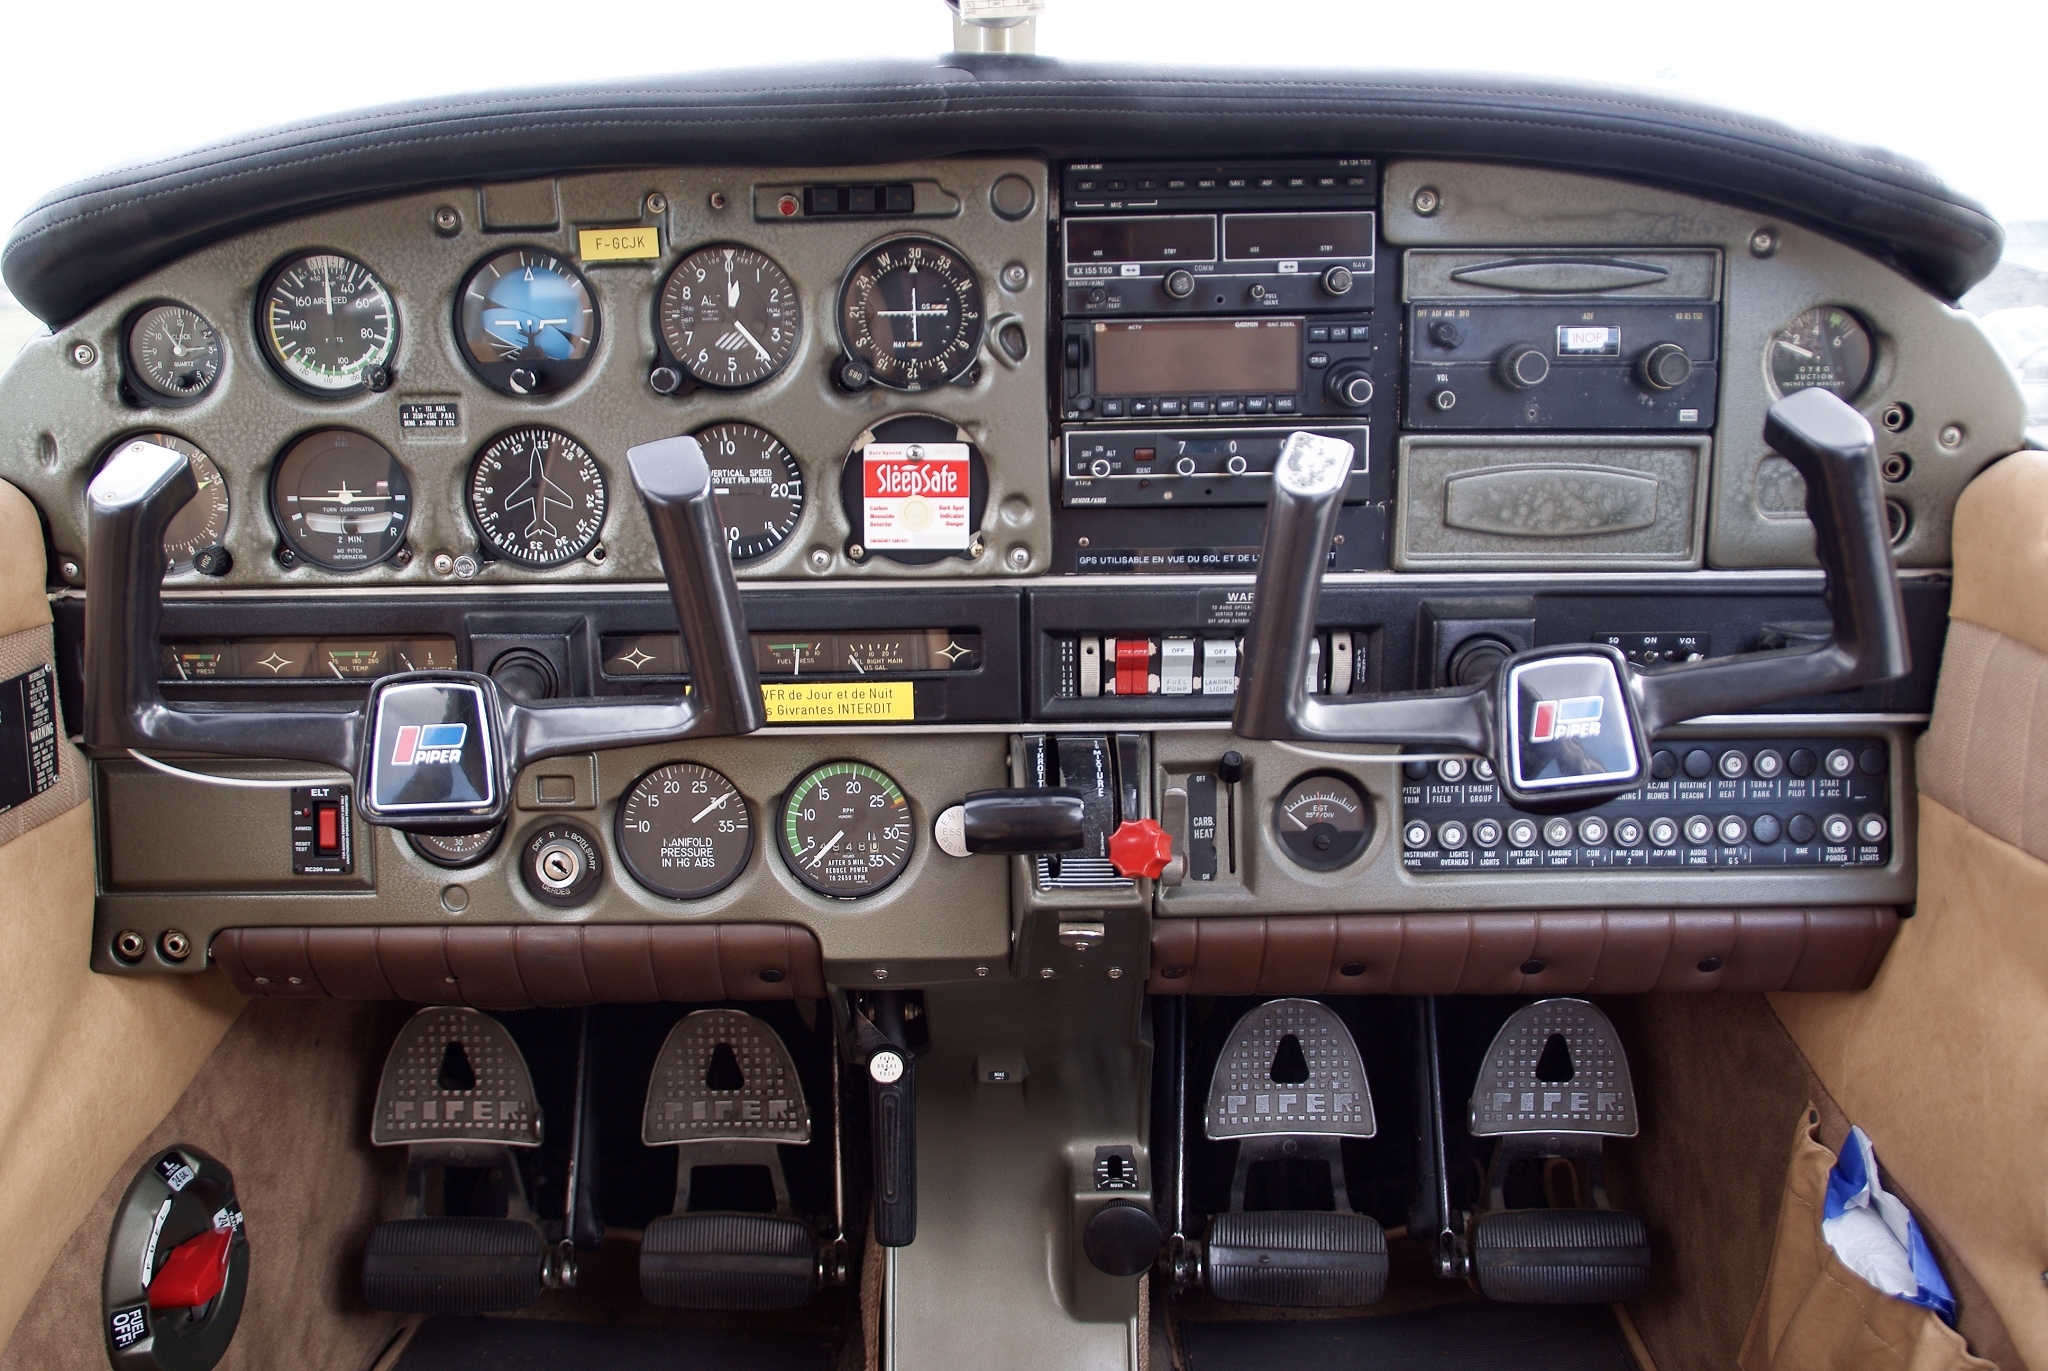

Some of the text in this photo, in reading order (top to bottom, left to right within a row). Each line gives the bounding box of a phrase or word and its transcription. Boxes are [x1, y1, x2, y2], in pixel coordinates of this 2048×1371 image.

[596, 236, 645, 250] F-GCJK
[908, 248, 922, 258] 30
[1074, 267, 1112, 275] KX 155 TSO
[856, 275, 870, 288] 24
[296, 296, 312, 306] 160
[356, 298, 370, 308] 60
[360, 328, 374, 338] 80
[1572, 332, 1604, 344] INOP
[848, 369, 862, 380] OBS
[1437, 374, 1448, 382] VOL
[720, 440, 736, 455] 10
[750, 468, 772, 476] SPEED
[876, 463, 958, 496] SleepSafe
[770, 483, 789, 498] 20
[201, 554, 212, 568] HDG
[1080, 556, 1097, 564] GPS
[1100, 555, 1150, 564] UTILISABLE
[1153, 555, 1164, 564] EN
[1168, 554, 1185, 563] VUE
[1188, 554, 1200, 563] DU
[1203, 554, 1220, 562] SOL
[1223, 554, 1234, 562] ET
[1238, 554, 1250, 562] DE
[1608, 637, 1620, 645] SQ
[1644, 636, 1658, 644] ON
[1679, 637, 1696, 645] VOL
[788, 688, 803, 700] de
[806, 688, 834, 700] Jour
[836, 688, 848, 700] et
[852, 688, 866, 700] de
[869, 687, 894, 699] Nuit
[777, 704, 834, 716] Givrantes
[838, 702, 892, 715] INTERDIT
[29, 721, 54, 744] WARNING
[1554, 721, 1602, 740] PIPER
[414, 749, 462, 764] PIPER
[1093, 750, 1104, 798] MIXTURE
[664, 780, 680, 794] 20
[692, 780, 708, 794] 25
[846, 781, 862, 795] 20
[1468, 784, 1494, 792] ENGINE
[1679, 781, 1707, 789] ROTATING
[1718, 780, 1736, 788] PITOT
[1788, 780, 1805, 788] AUTO
[1820, 779, 1840, 787] START
[311, 788, 330, 796] ELT
[818, 788, 830, 802] 15
[1403, 786, 1421, 794] PITCH
[1647, 792, 1670, 800] BLOWER
[1681, 791, 1704, 800] BEACON
[1720, 790, 1736, 798] HEAT
[1752, 790, 1770, 798] BANK
[1788, 790, 1806, 798] PILOT
[648, 794, 660, 807] 15
[869, 794, 885, 808] 25
[1404, 796, 1420, 804] TRIM
[1432, 795, 1452, 804] FIELD
[1470, 794, 1492, 802] GROUP
[804, 808, 816, 821] 10
[638, 820, 650, 833] 10
[718, 820, 735, 833] 35
[1193, 816, 1216, 826] CARB.
[883, 826, 900, 840] 30
[1194, 829, 1214, 839] HEAT
[532, 836, 544, 852] OFF
[570, 832, 588, 852] BOTH
[586, 847, 596, 870] START
[660, 847, 714, 858] PRESSURE
[1860, 853, 1880, 861] LIGHTS
[662, 858, 716, 868] IN HG ABS
[868, 854, 884, 868] 35
[1690, 856, 1708, 864] PANEL
[1226, 1093, 1352, 1114] PIPER
[1492, 1092, 1618, 1113] PIPER
[394, 1101, 518, 1121] PIPER
[665, 1101, 788, 1121] PIPER
[166, 1163, 182, 1177] TANK
[112, 1312, 132, 1343] OFF
[128, 1308, 144, 1340] FUEL
